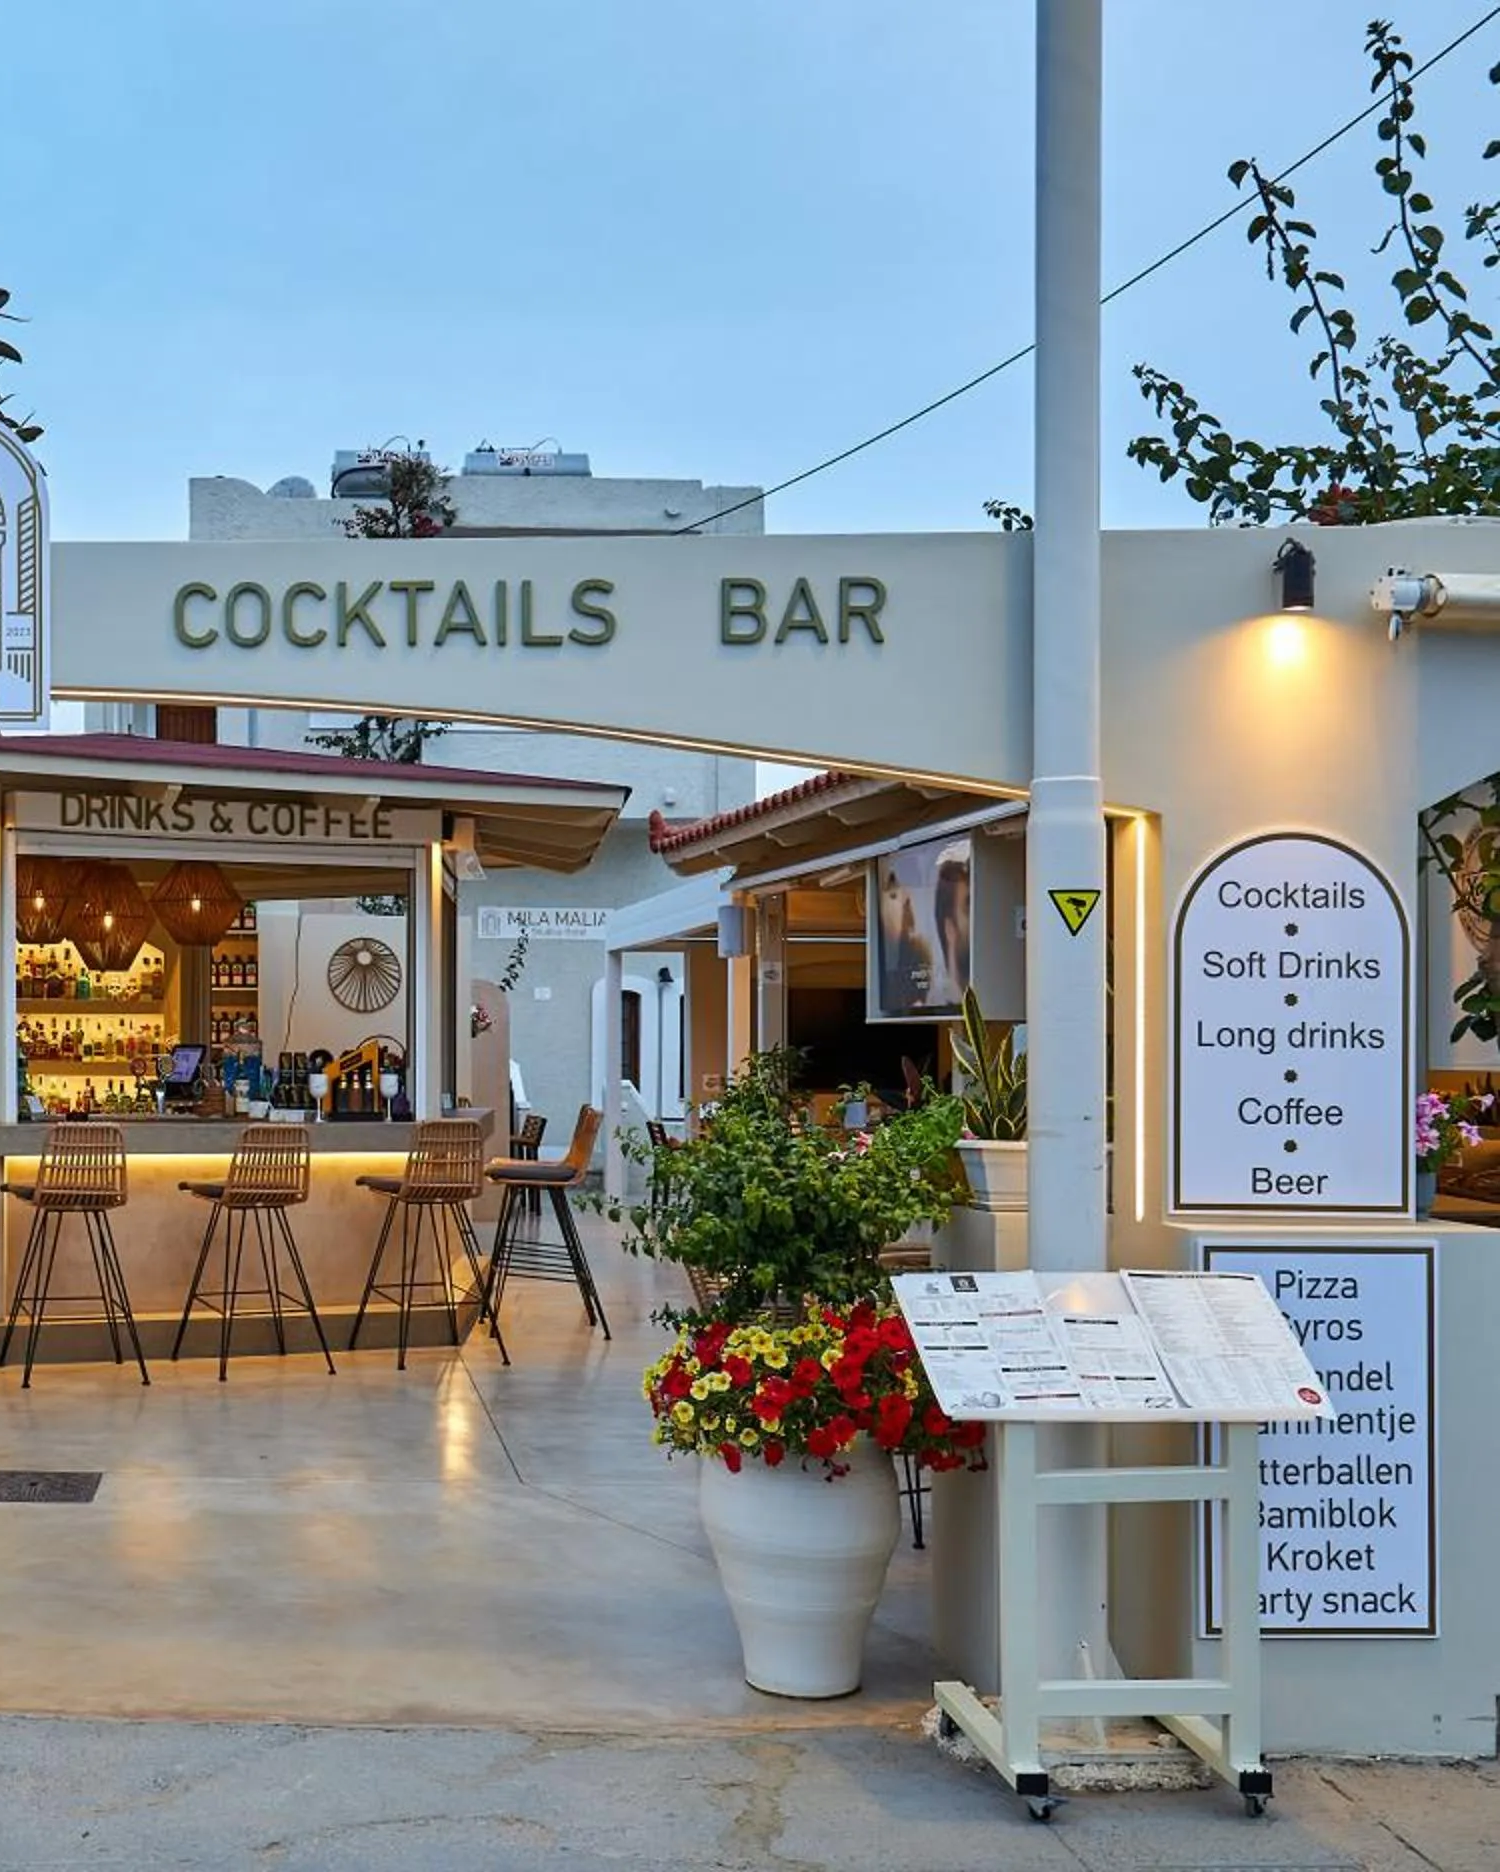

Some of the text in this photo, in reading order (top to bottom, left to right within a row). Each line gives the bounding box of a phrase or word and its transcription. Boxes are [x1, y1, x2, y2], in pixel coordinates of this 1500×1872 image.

[173, 576, 887, 648] COCKTAILS BAR
[60, 790, 393, 840] DRINKS & COFFEE
[1218, 881, 1365, 909] Cocktails
[1203, 951, 1381, 979] Soft Drinks
[1197, 1021, 1385, 1055] Long drinks
[1238, 1097, 1343, 1126] Coffee
[1251, 1168, 1329, 1195] Beer
[1275, 1270, 1359, 1300] Pizza
[1281, 1311, 1363, 1347] yros
[1267, 1540, 1376, 1571] Kroket
[1323, 1583, 1417, 1615] snack
